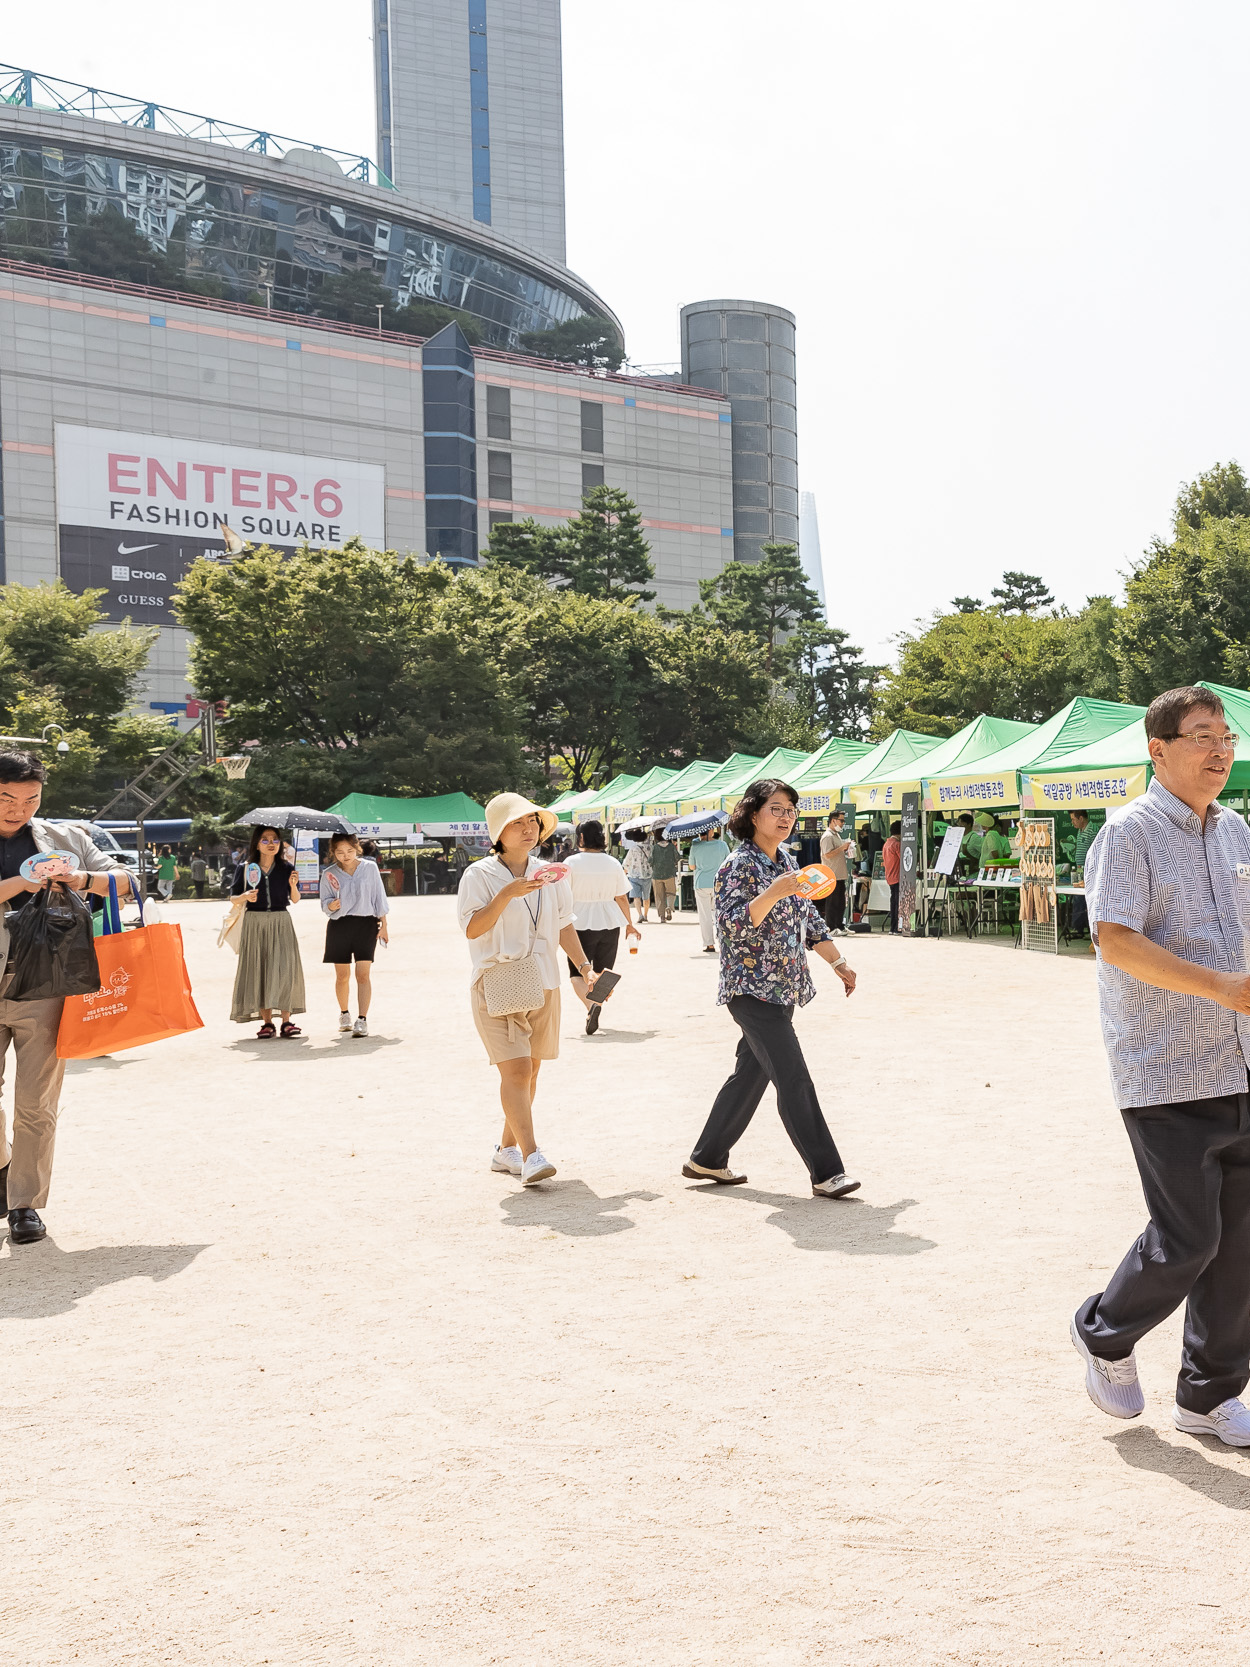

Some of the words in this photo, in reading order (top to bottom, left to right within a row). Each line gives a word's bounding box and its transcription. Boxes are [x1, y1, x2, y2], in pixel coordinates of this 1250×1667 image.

[107, 452, 344, 519] ENTER-6
[110, 500, 229, 530] FASHION
[241, 515, 342, 543] SQUARE
[131, 570, 167, 581] 다이소
[117, 594, 165, 607] GUESS
[938, 785, 963, 804] 함께누리
[963, 780, 1005, 800] 사회적협동조합
[1043, 783, 1073, 801] 태일공방
[1074, 777, 1128, 799] 사회적협동조합
